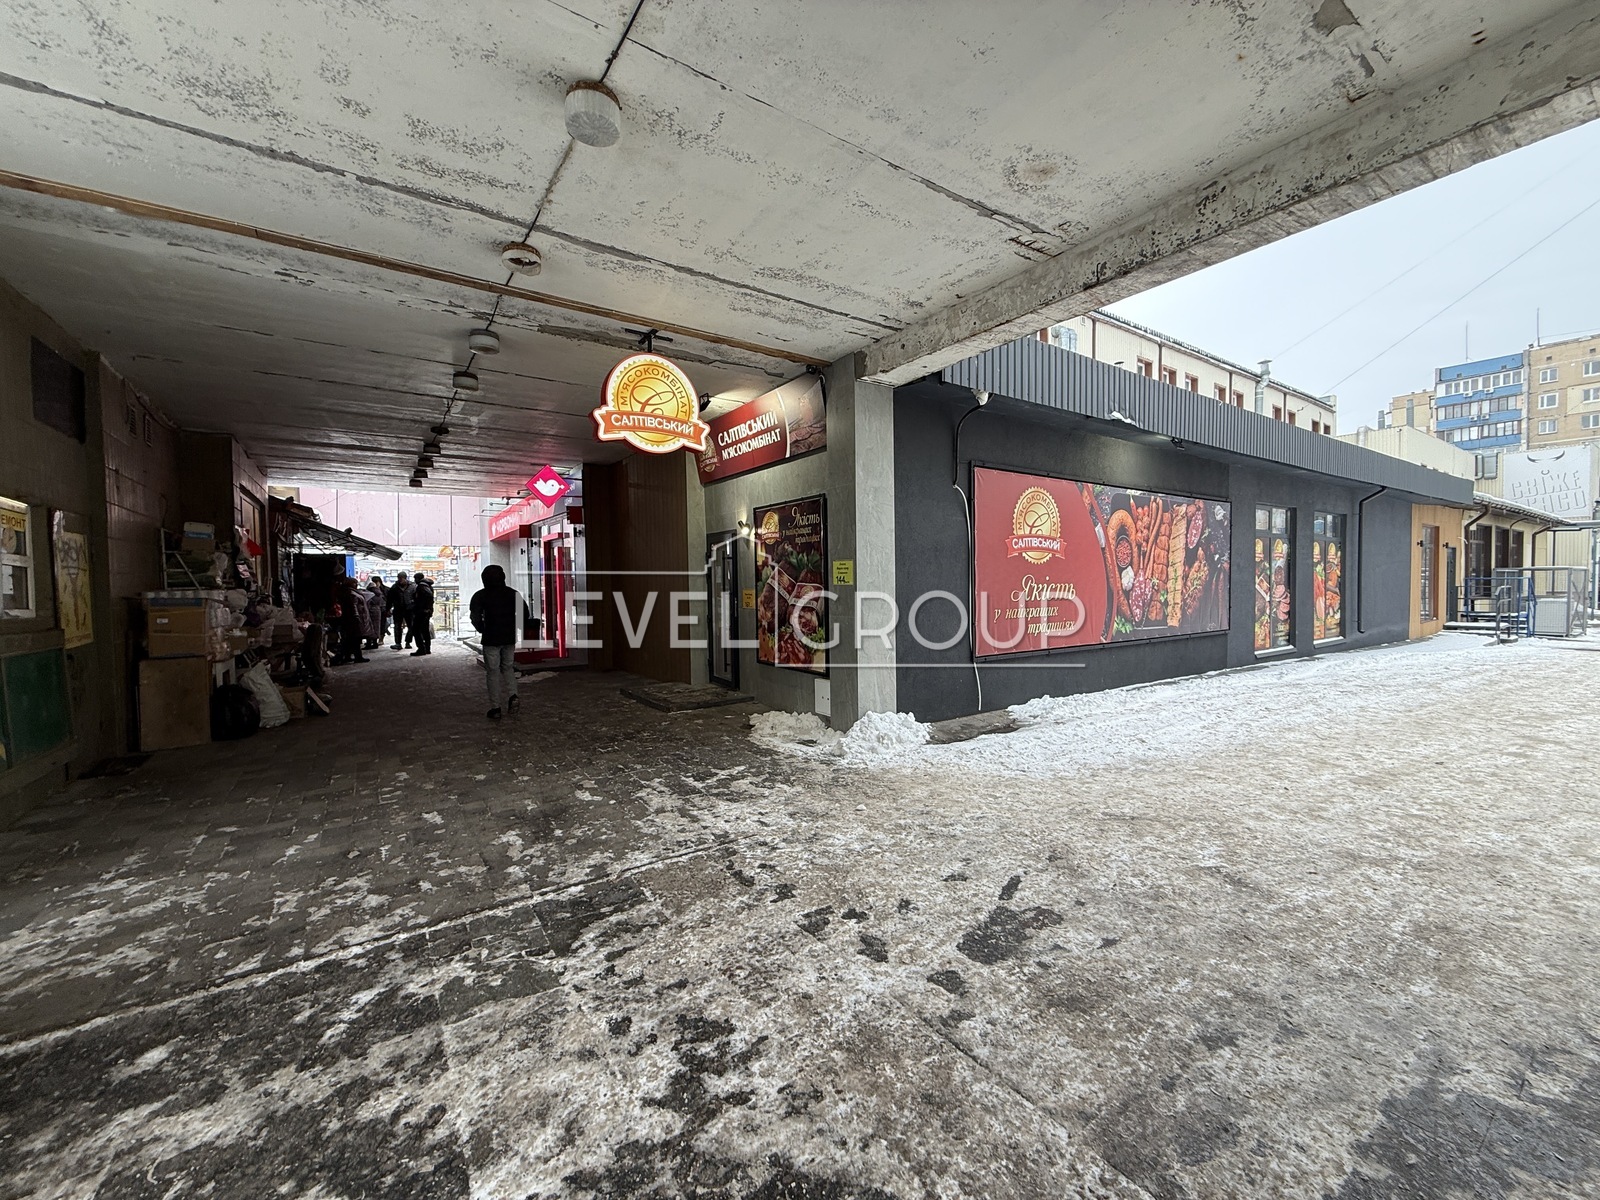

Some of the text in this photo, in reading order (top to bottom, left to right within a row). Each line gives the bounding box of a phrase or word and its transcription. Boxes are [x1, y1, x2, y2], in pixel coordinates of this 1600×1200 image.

[621, 367, 687, 416] М'ЯСОКОМБІНАТ
[611, 414, 694, 436] САЛТІВСЬКИЙ
[722, 428, 781, 460] М'ЯСОКОМБІНАТ
[1509, 470, 1581, 500] СВІЖЕ
[1018, 493, 1057, 532] М'ЯСОКОМБІНАТ
[1511, 489, 1587, 513] 'ЯСО
[788, 507, 820, 527] Якість
[1012, 537, 1060, 550] САЛТІВСЬКИЙ
[1010, 574, 1076, 602] Якість
[993, 603, 1059, 623] у найкращих
[1027, 617, 1076, 636] традиціях
